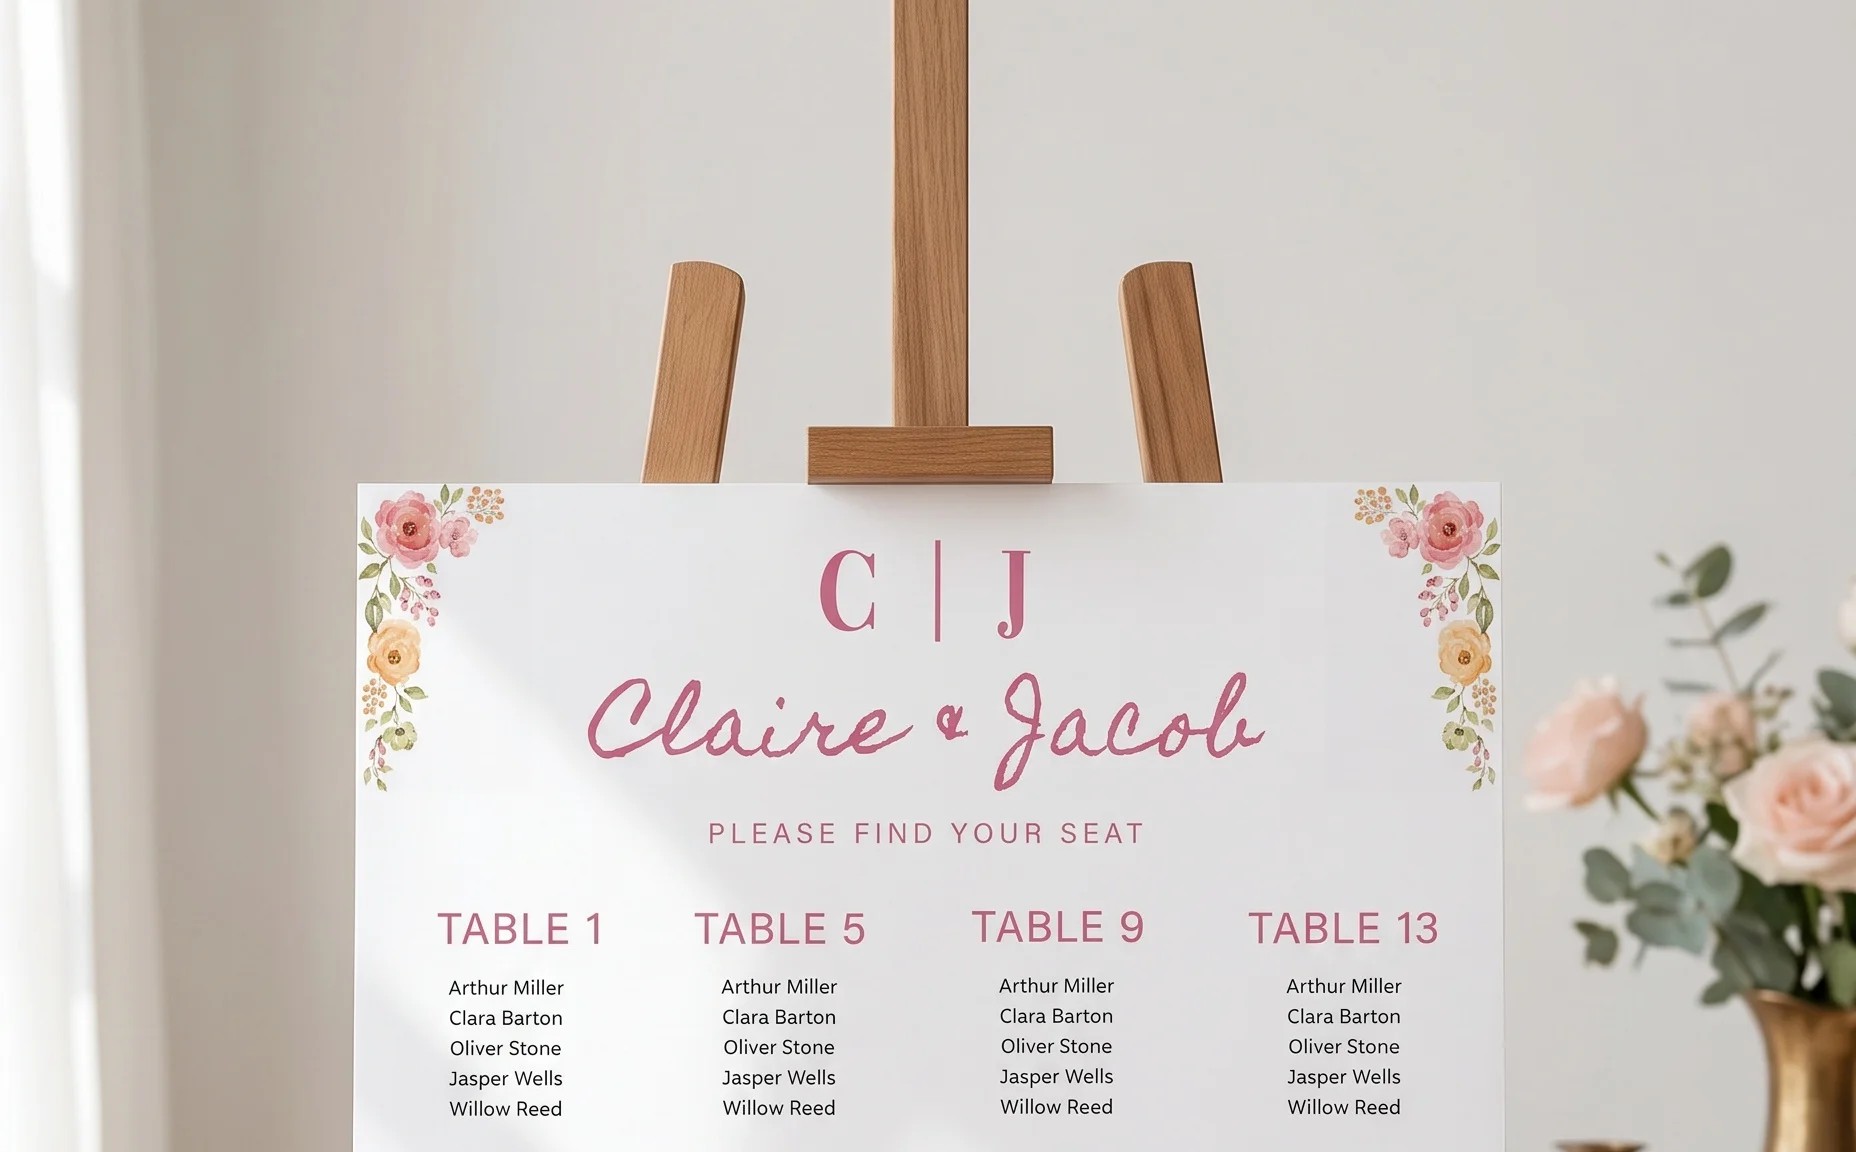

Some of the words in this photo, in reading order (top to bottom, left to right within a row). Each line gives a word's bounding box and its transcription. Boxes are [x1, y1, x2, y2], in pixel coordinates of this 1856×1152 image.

[819, 549, 875, 632] C
[997, 550, 1031, 640] J
[587, 677, 914, 760] Claire
[936, 704, 969, 741] &
[993, 671, 1266, 792] Jacob
[709, 822, 835, 844] PLEASE
[855, 822, 932, 844] FIND
[950, 822, 1041, 844] YOUR
[1060, 822, 1143, 844] SEAT
[437, 912, 569, 945] TABLE
[586, 912, 599, 945] 1
[694, 912, 826, 945] TABLE
[843, 912, 865, 945] 5
[971, 910, 1104, 943] TABLE
[1120, 910, 1144, 944] 9
[1248, 912, 1380, 944] TABLE
[1397, 911, 1438, 944] 13
[448, 979, 509, 996] Arthur
[513, 978, 565, 996] Miller
[998, 976, 1059, 994] Arthur
[1064, 976, 1115, 994] Miller
[449, 1009, 497, 1026] Clara
[502, 1009, 563, 1026] Barton
[999, 1007, 1047, 1024] Clara
[1052, 1007, 1113, 1024] Barton
[1287, 1007, 1335, 1025] Clara
[1339, 1008, 1401, 1025] Barton
[450, 1039, 504, 1057] Oliver
[508, 1040, 562, 1056] Stone
[723, 1038, 778, 1056] Oliver
[782, 1038, 835, 1056] Stone
[1288, 1037, 1343, 1055] Oliver
[1346, 1038, 1400, 1055] Stone
[448, 1070, 510, 1091] Jasper
[514, 1069, 563, 1087] Wells
[721, 1069, 783, 1090] Jasper
[786, 1068, 836, 1086] Wells
[1287, 1069, 1348, 1089] Jasper
[1352, 1067, 1401, 1085] Wells
[722, 1098, 785, 1116] Willow
[790, 1098, 836, 1116] Reed
[999, 1097, 1062, 1115] Willow
[1067, 1097, 1113, 1115] Reed
[1287, 1098, 1350, 1116] Willow
[1355, 1098, 1401, 1116] Reed
